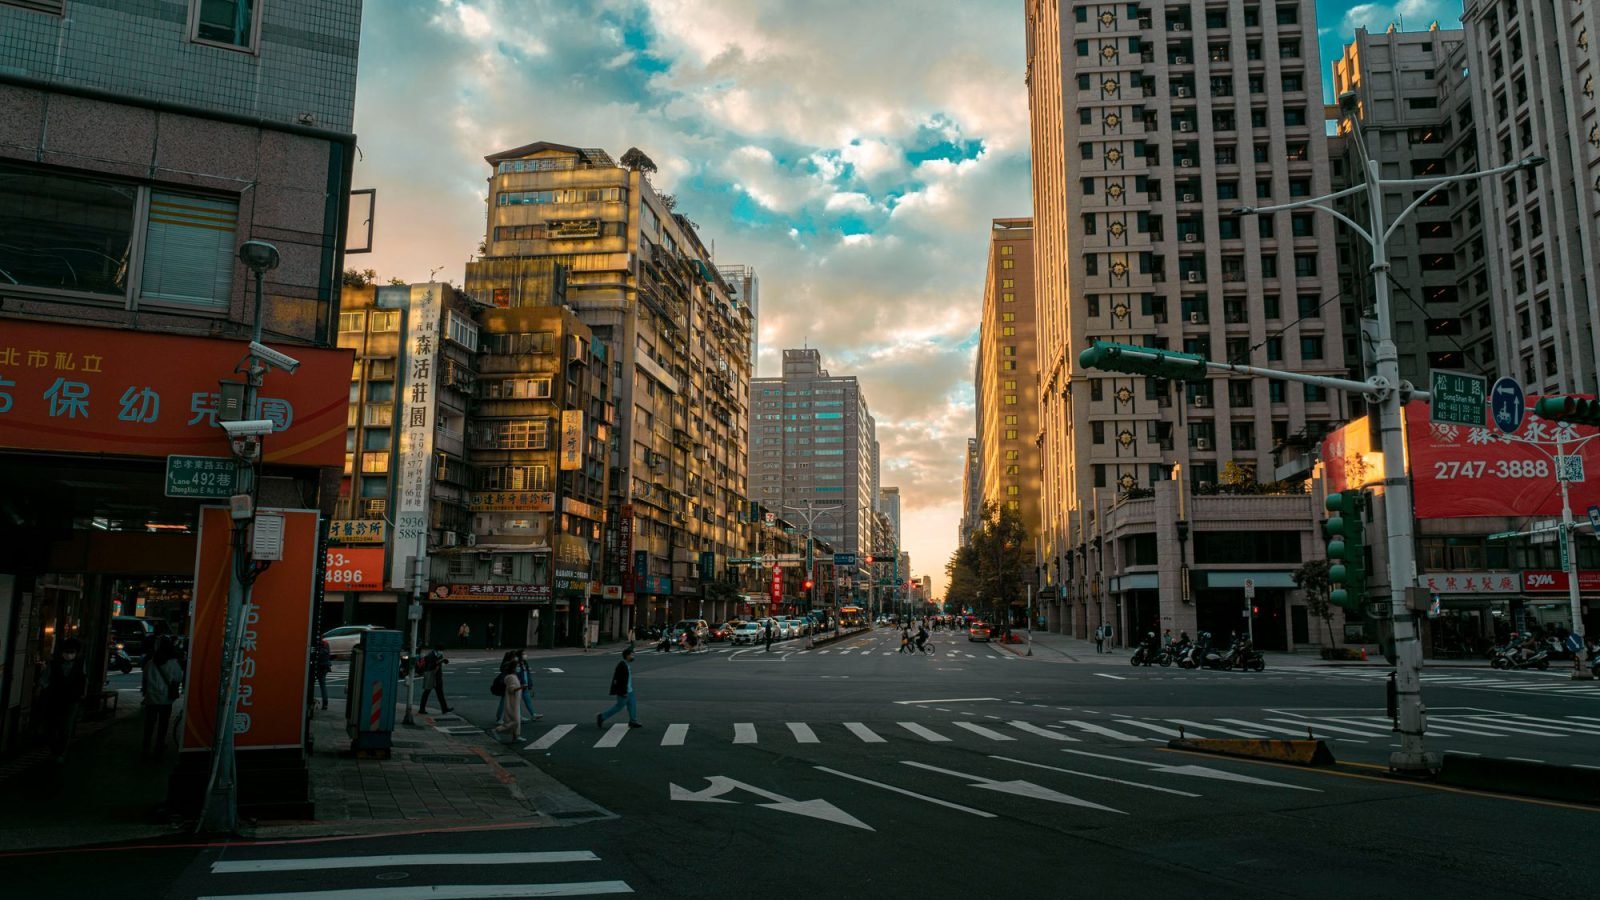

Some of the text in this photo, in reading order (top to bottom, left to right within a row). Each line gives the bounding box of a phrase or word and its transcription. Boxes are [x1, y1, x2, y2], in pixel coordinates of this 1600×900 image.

[0, 347, 103, 373] 北市私立
[410, 335, 431, 428] 森活莊園
[1437, 374, 1481, 396] 松山路
[173, 459, 234, 471] 忠孝東路五段
[1434, 459, 1549, 480] 2747-3888
[173, 477, 191, 486] Lane
[330, 521, 382, 536] 牙醫診所
[399, 517, 424, 528] 2936
[325, 569, 363, 583] 4896
[1527, 573, 1556, 588] SYM
